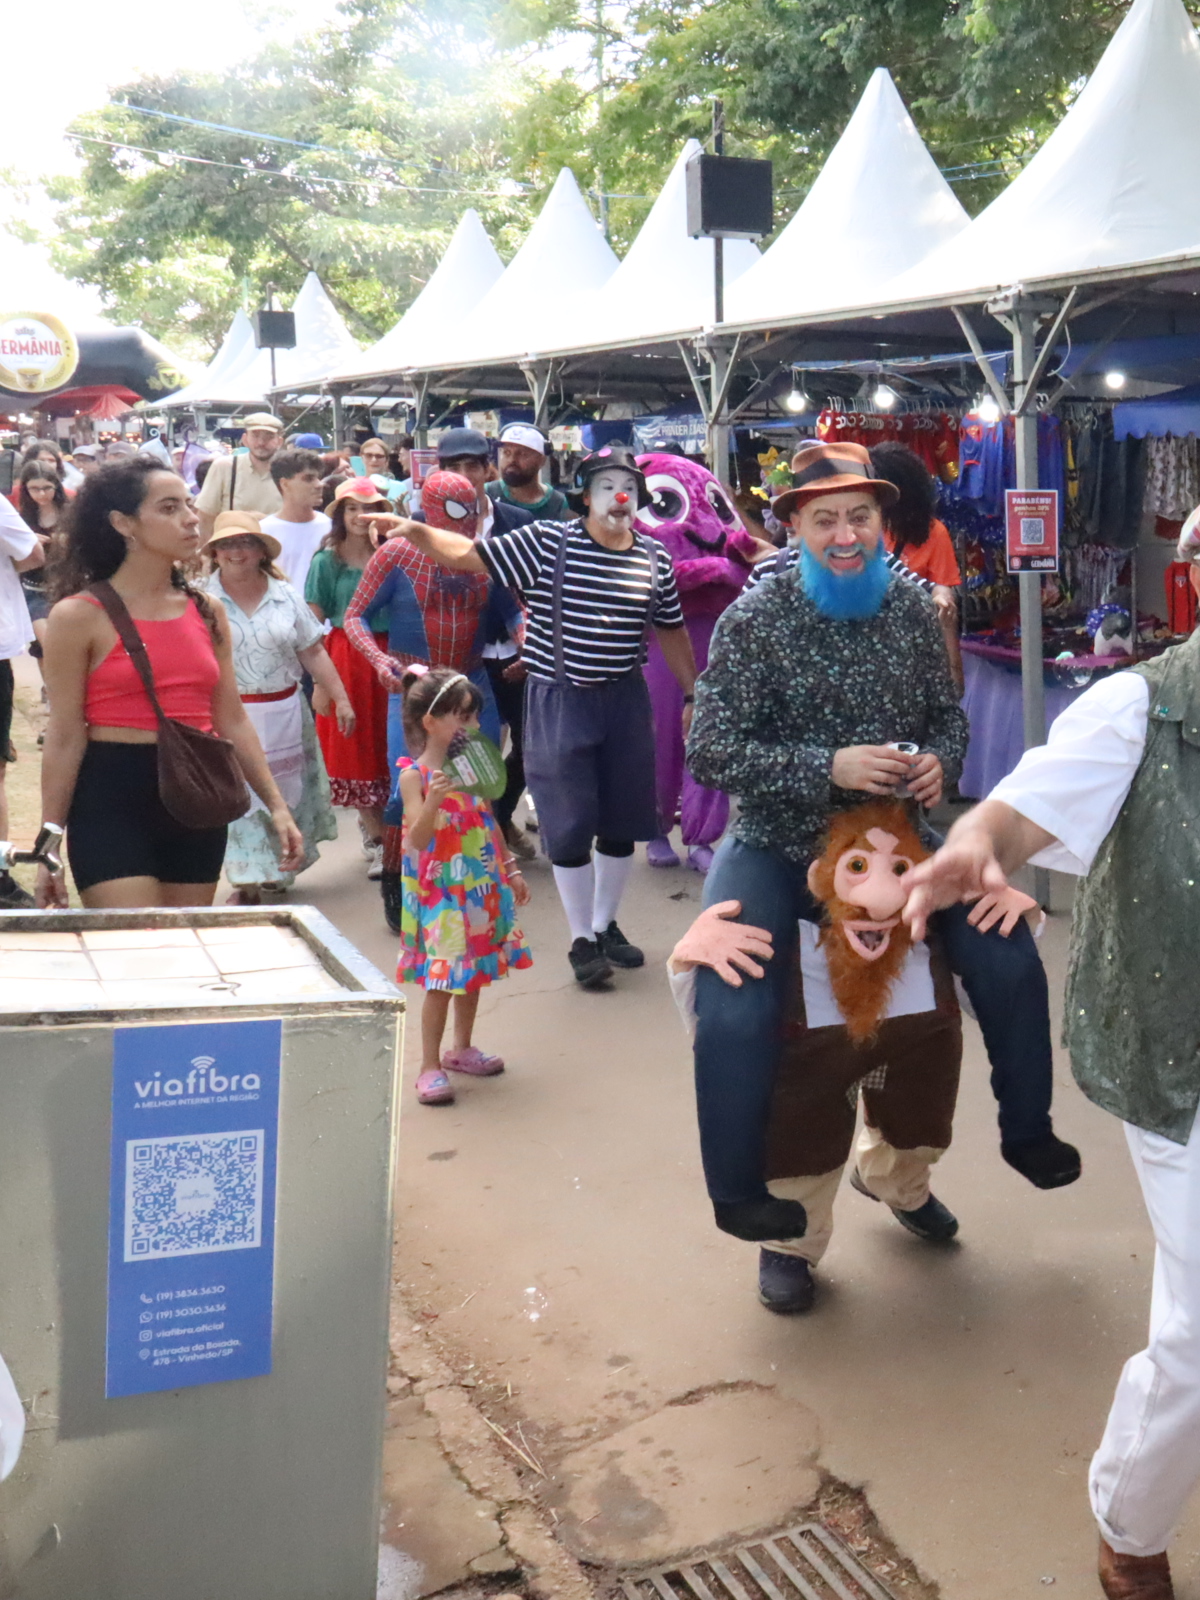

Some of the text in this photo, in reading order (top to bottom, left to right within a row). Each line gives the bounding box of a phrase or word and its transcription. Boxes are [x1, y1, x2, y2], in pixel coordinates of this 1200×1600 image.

[0, 337, 62, 356] ERMÂNIA
[134, 1067, 261, 1098] viafibra
[142, 1099, 177, 1109] MELHOR
[178, 1096, 215, 1106] INTERNET
[216, 1095, 228, 1103] DA
[229, 1092, 260, 1102] REGIÃO
[156, 1291, 173, 1302] (19)
[156, 1310, 173, 1321] (19)
[155, 1321, 225, 1338] viafibra.oficial
[153, 1345, 191, 1357] Estrada
[178, 1347, 234, 1363] Vinhedo/SP
